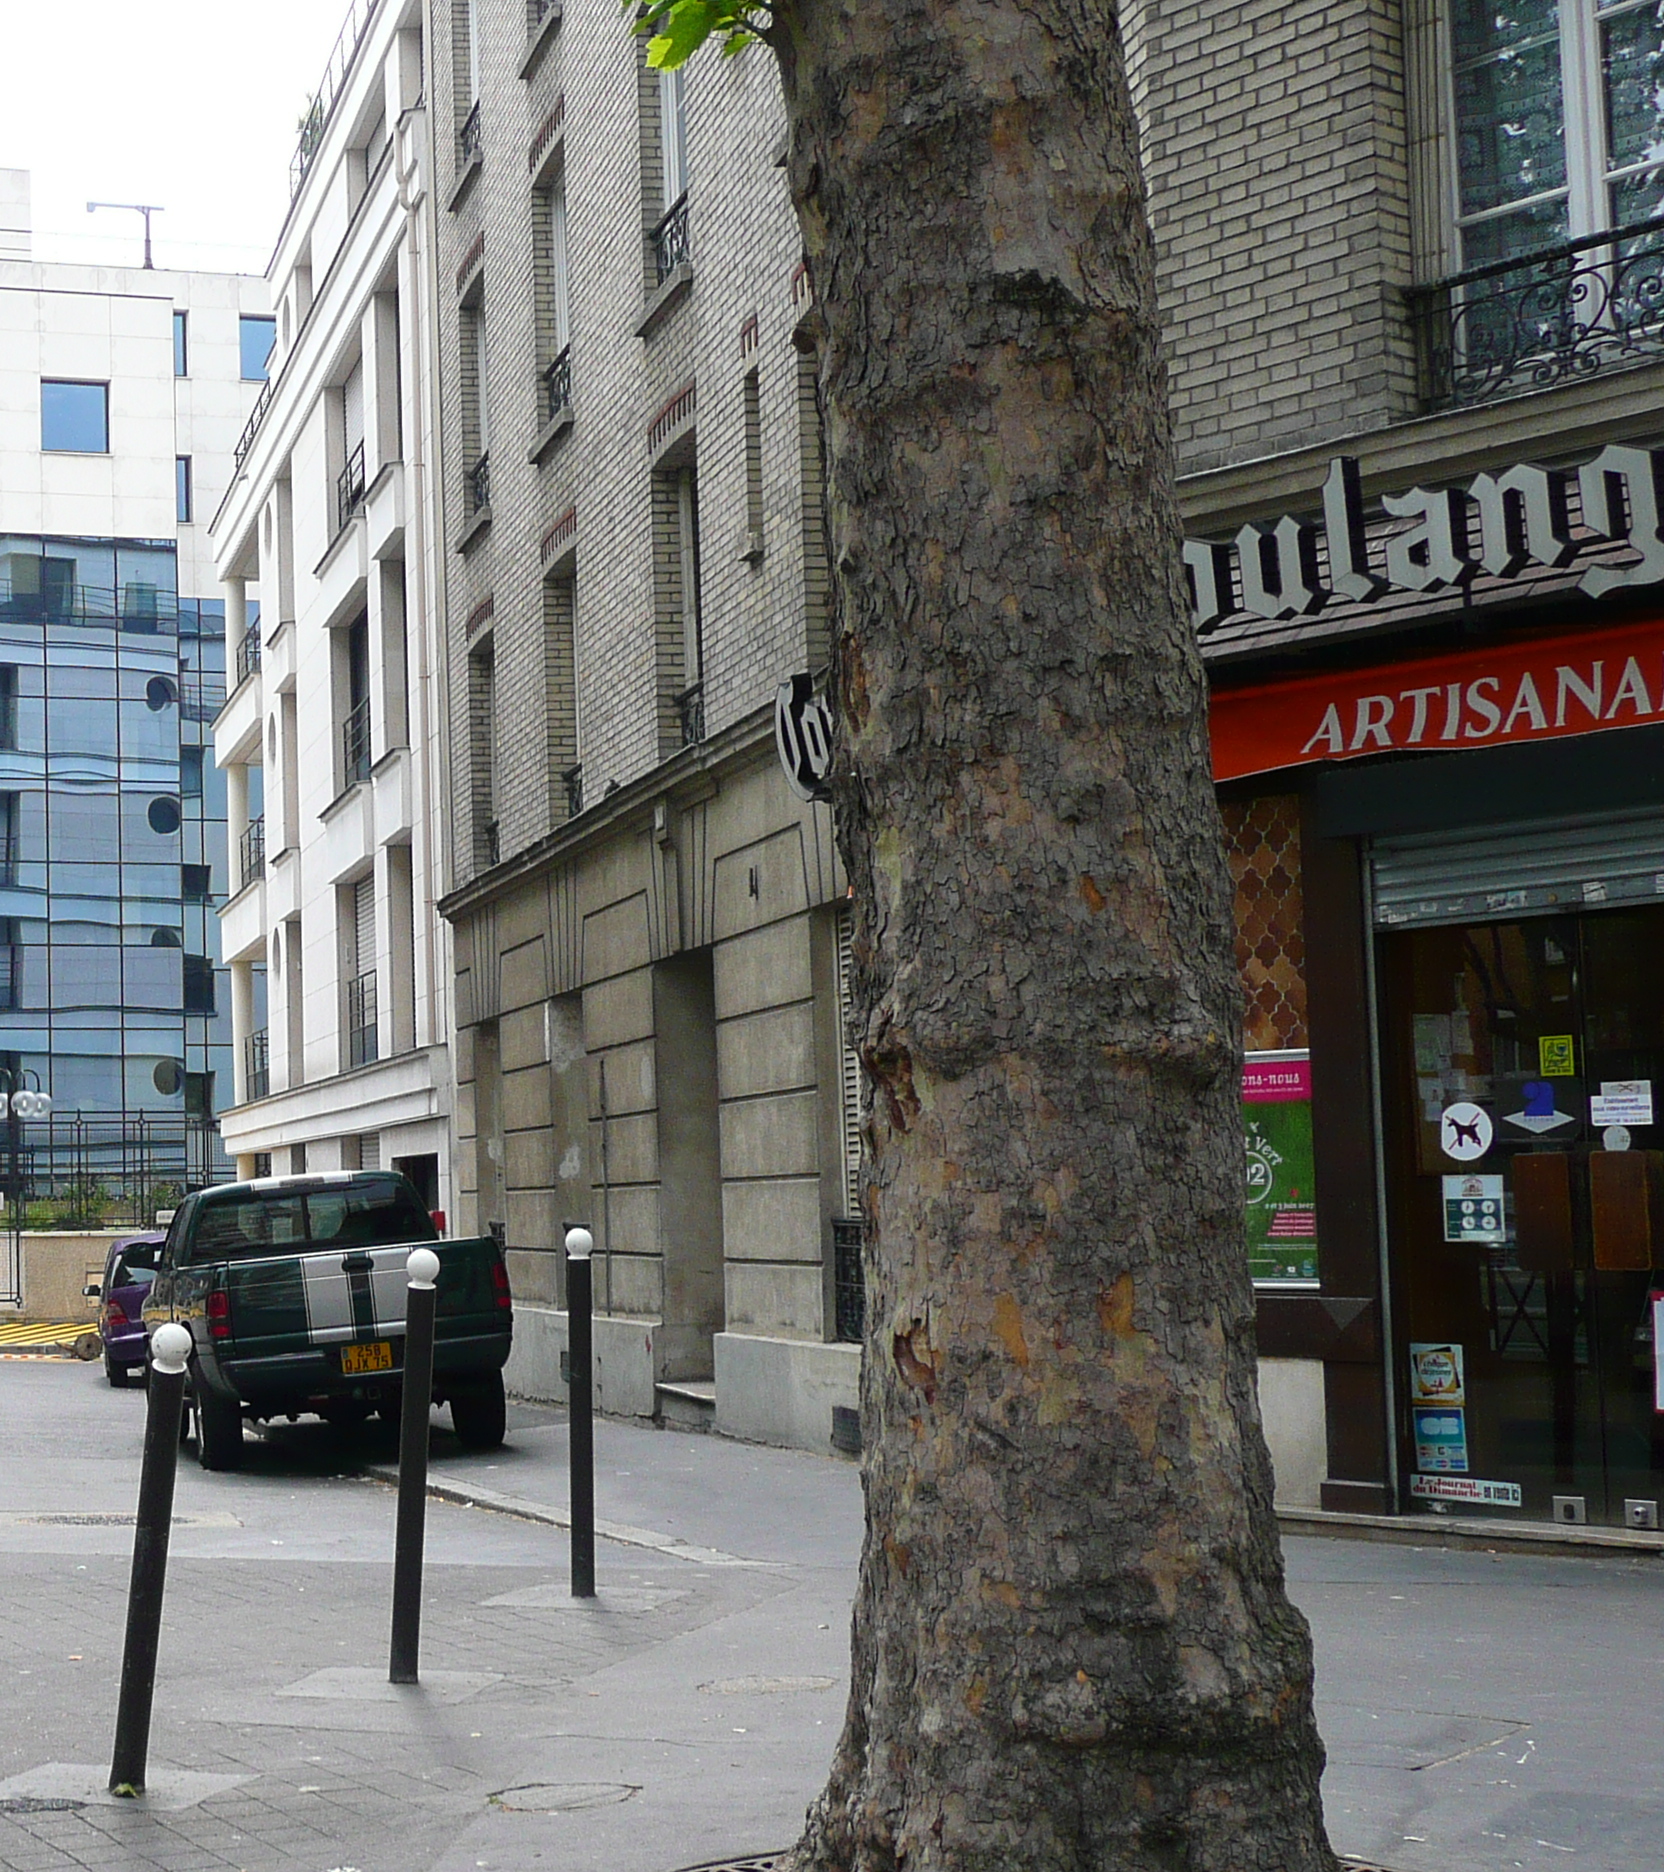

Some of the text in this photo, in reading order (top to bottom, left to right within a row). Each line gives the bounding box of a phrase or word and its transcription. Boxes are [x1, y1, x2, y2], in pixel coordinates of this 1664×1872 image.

[1300, 654, 1664, 754] ARTISANA
[1246, 1163, 1265, 1186] 2
[356, 1344, 382, 1358] 258
[372, 1354, 389, 1368] 75
[1434, 1477, 1477, 1489] Journal
